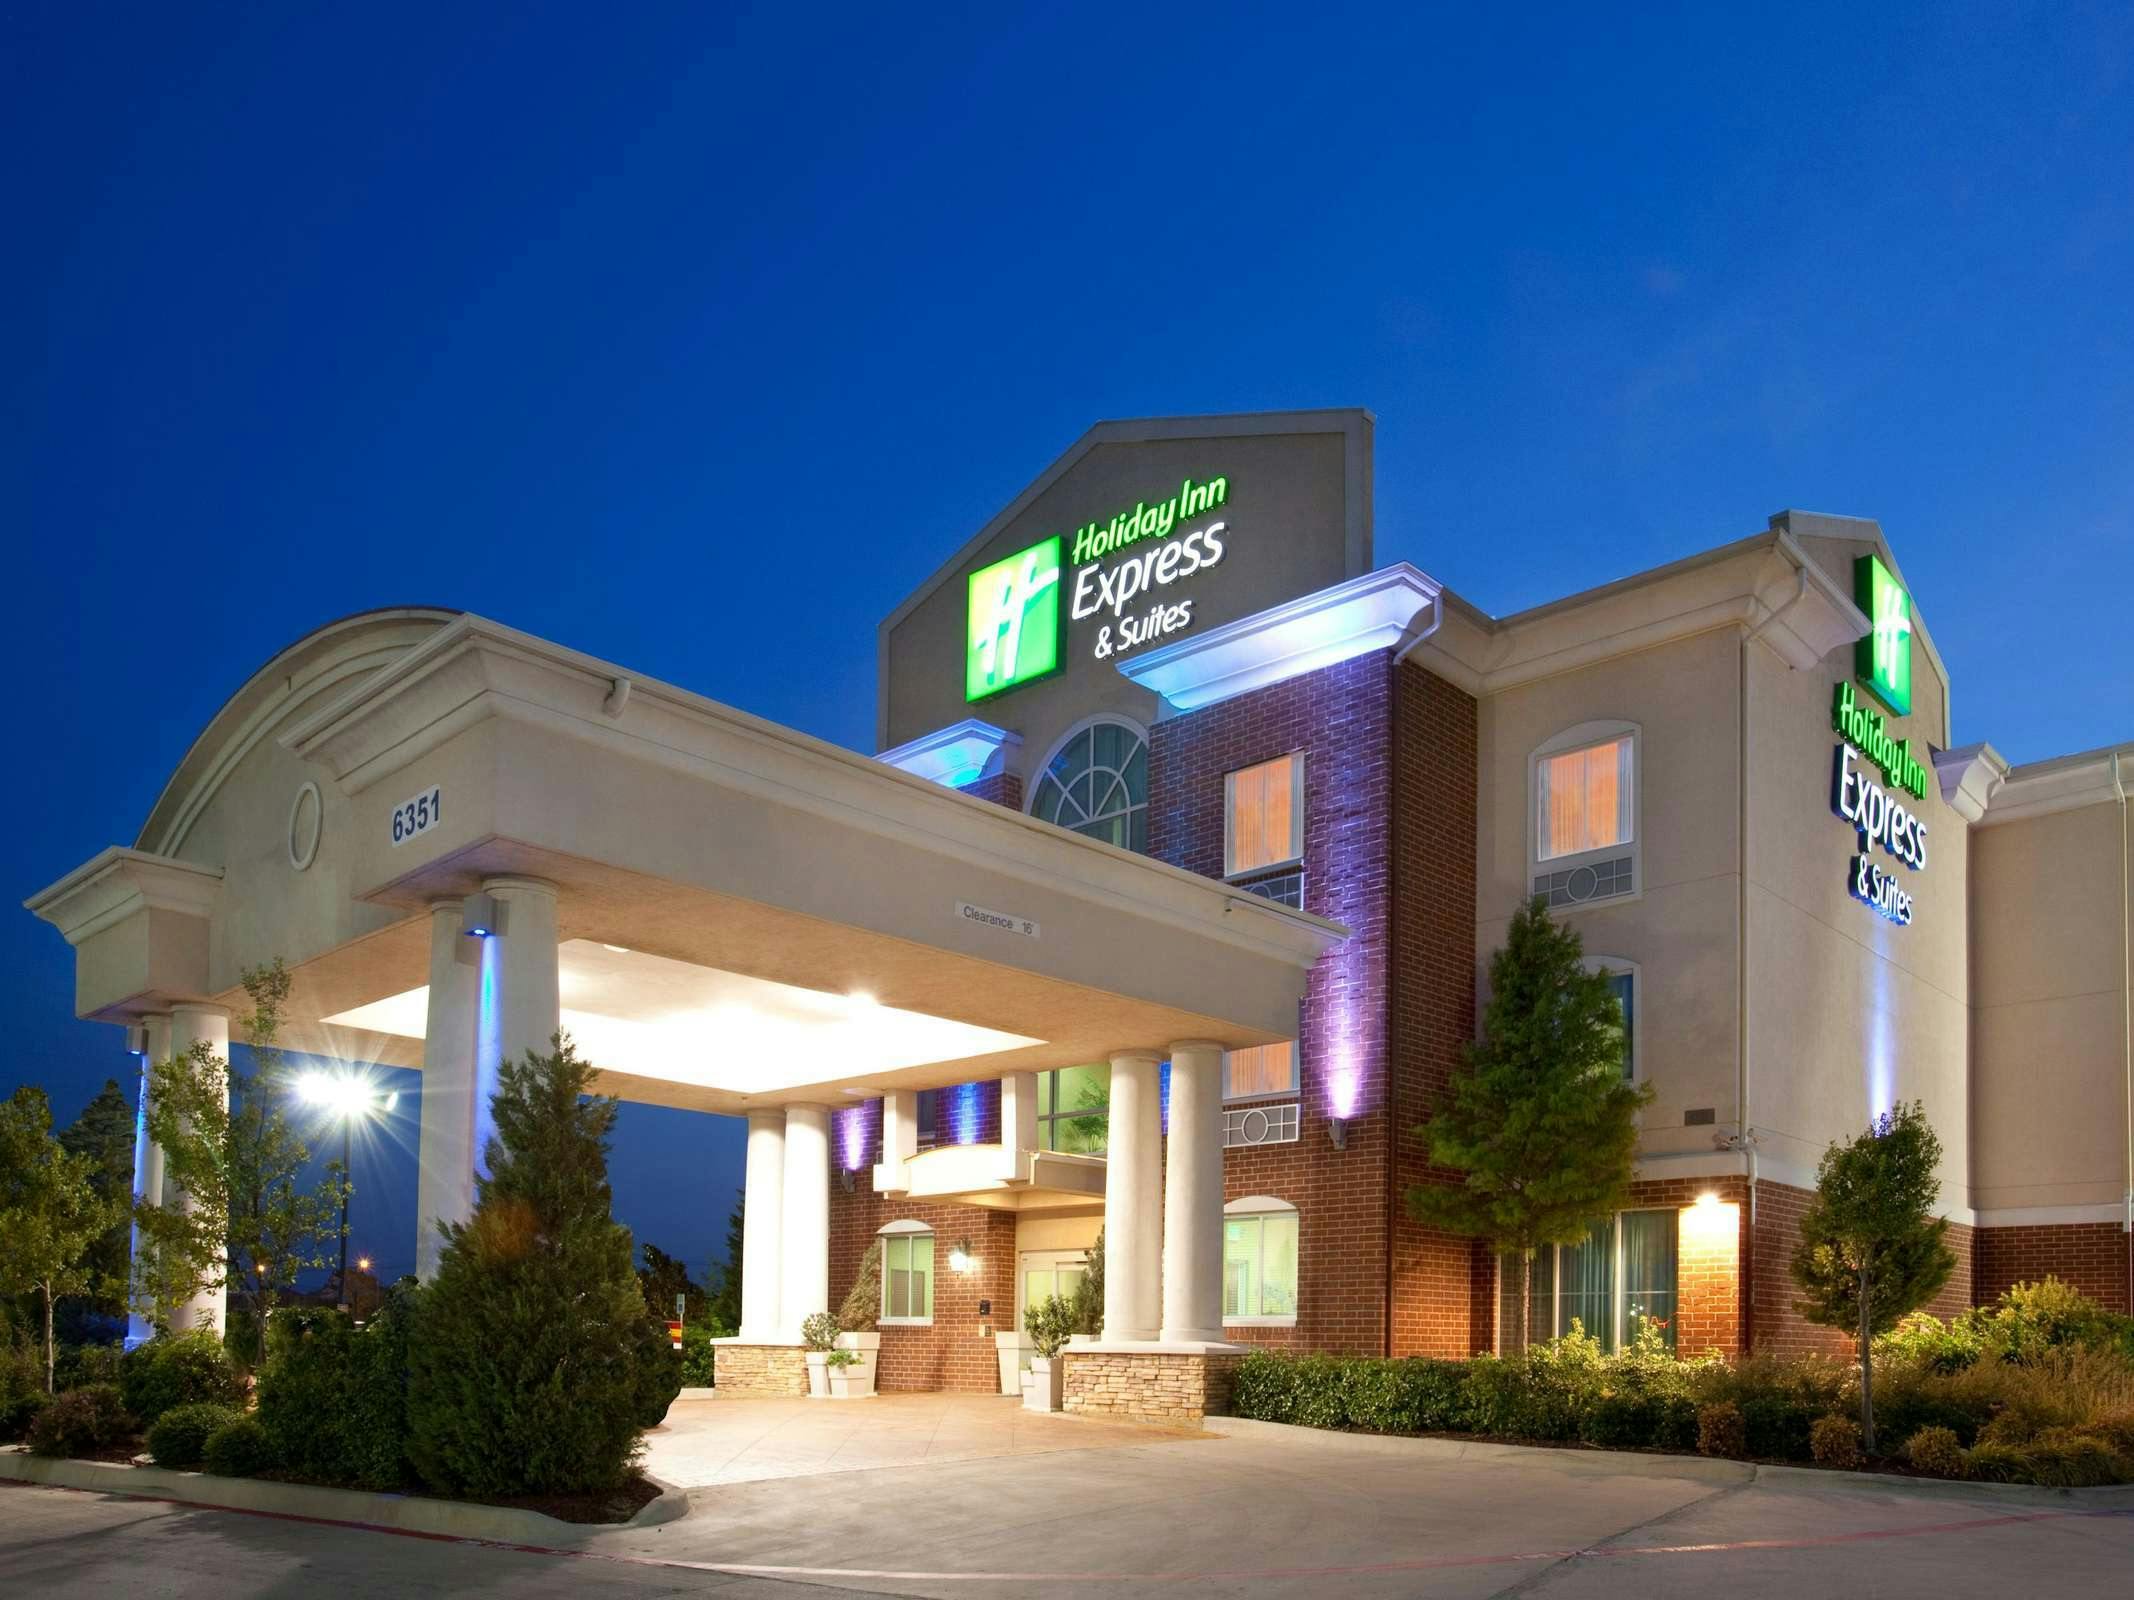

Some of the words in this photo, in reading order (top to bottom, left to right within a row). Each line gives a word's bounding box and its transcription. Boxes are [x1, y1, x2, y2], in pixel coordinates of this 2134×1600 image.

[1073, 497, 1177, 565] Holiday
[1179, 477, 1226, 518] Inn
[1072, 522, 1225, 619] Express
[1094, 626, 1113, 658] &
[1117, 600, 1192, 651] Suites
[1841, 681, 1903, 788] Holiday
[1904, 739, 1926, 798] Inn
[393, 788, 440, 842] 6351
[1841, 744, 1926, 870] Express
[963, 905, 1013, 929] Clearance
[1857, 855, 1869, 898] &
[1871, 864, 1913, 925] Suites
